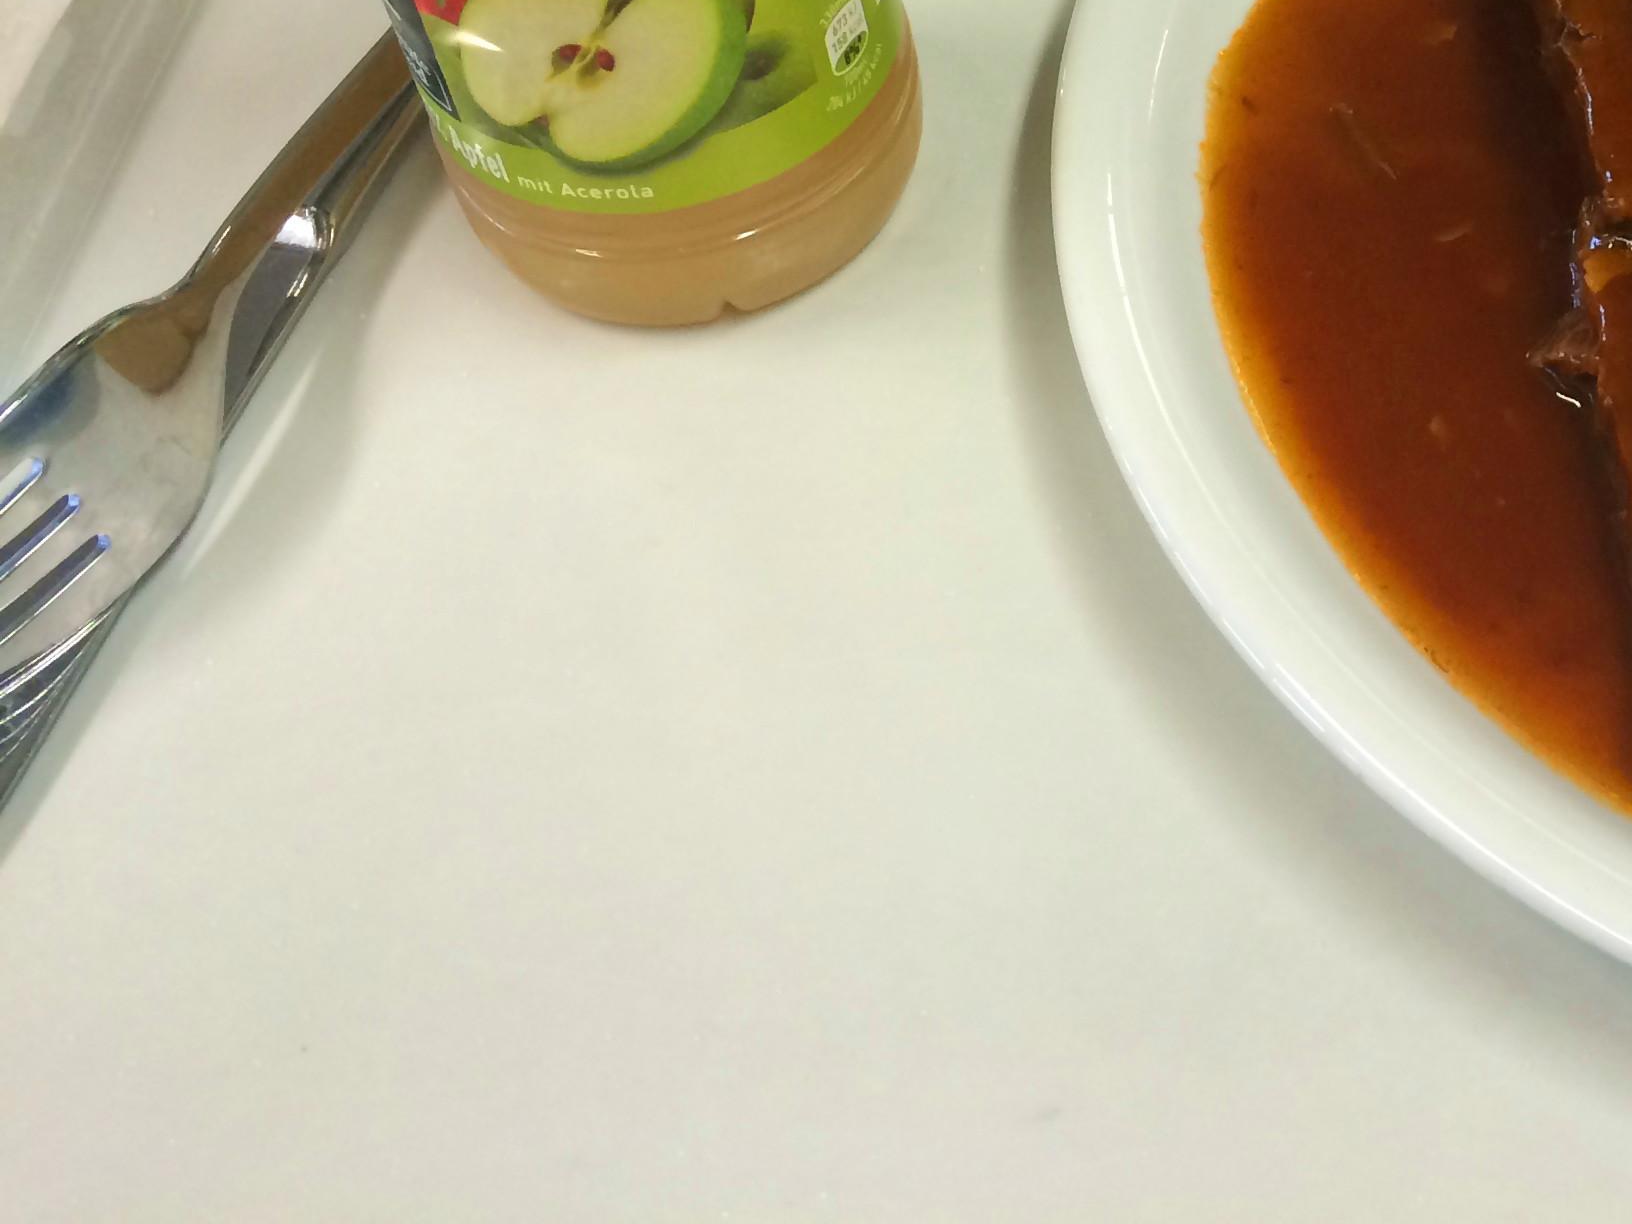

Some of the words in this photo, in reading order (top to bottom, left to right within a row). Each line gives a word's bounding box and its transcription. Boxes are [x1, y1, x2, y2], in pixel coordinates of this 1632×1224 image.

[448, 124, 511, 184] Apfel
[517, 175, 554, 195] mit
[561, 183, 655, 200] Acerola
